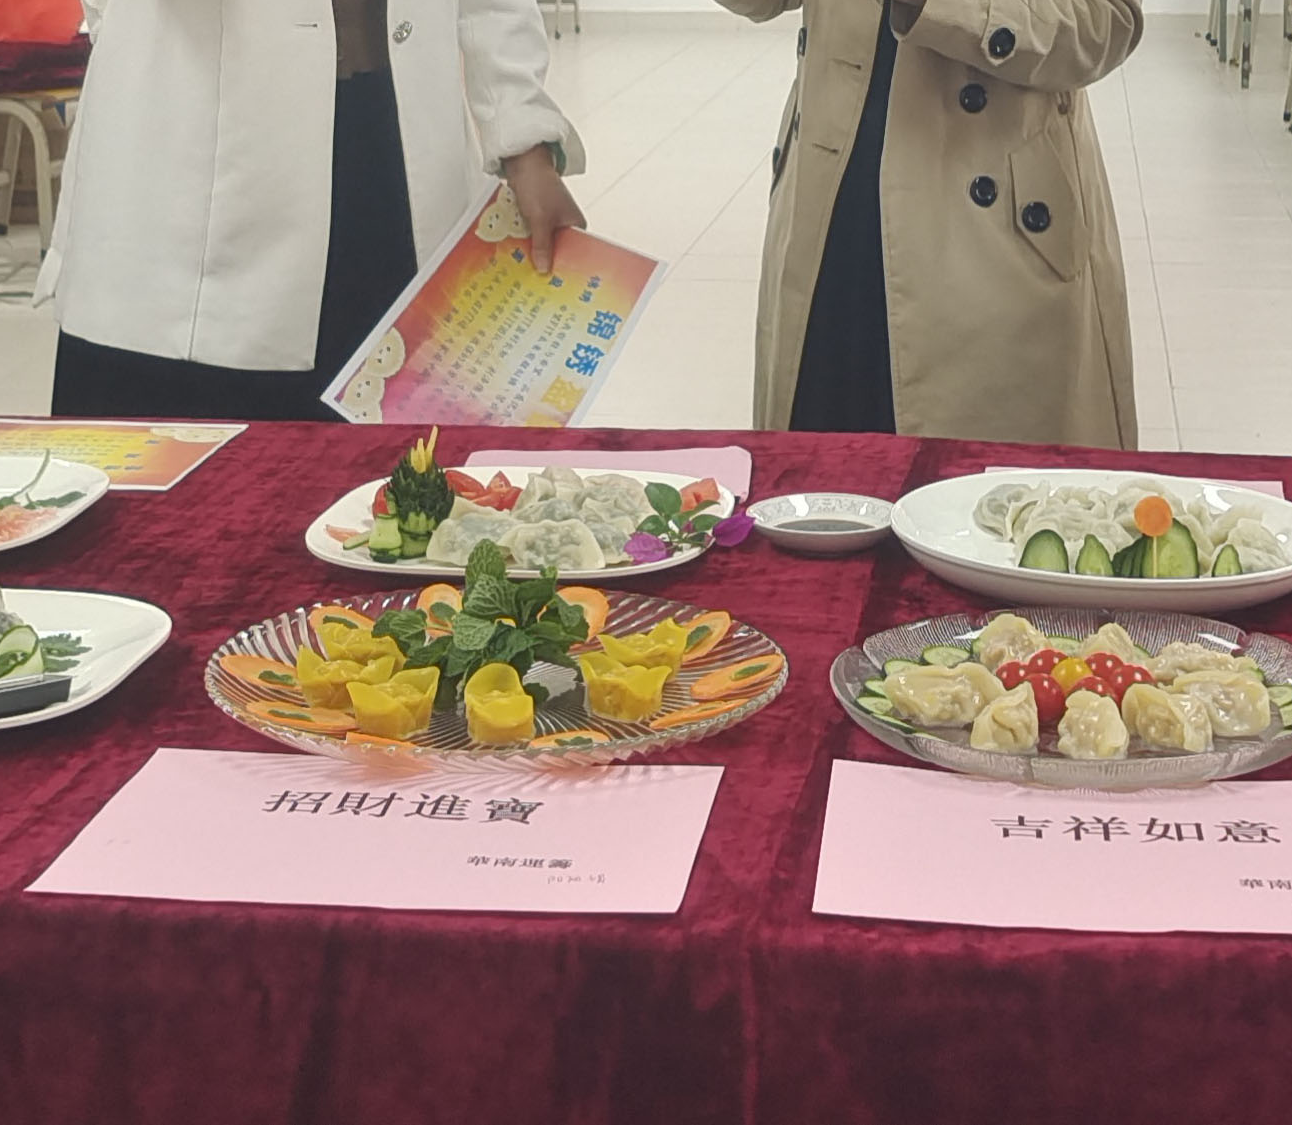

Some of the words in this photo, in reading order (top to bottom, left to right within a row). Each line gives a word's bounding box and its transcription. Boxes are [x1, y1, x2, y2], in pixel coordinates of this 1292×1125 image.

[261, 789, 546, 825] 招財進寶
[990, 814, 1284, 846] 吉祥如意
